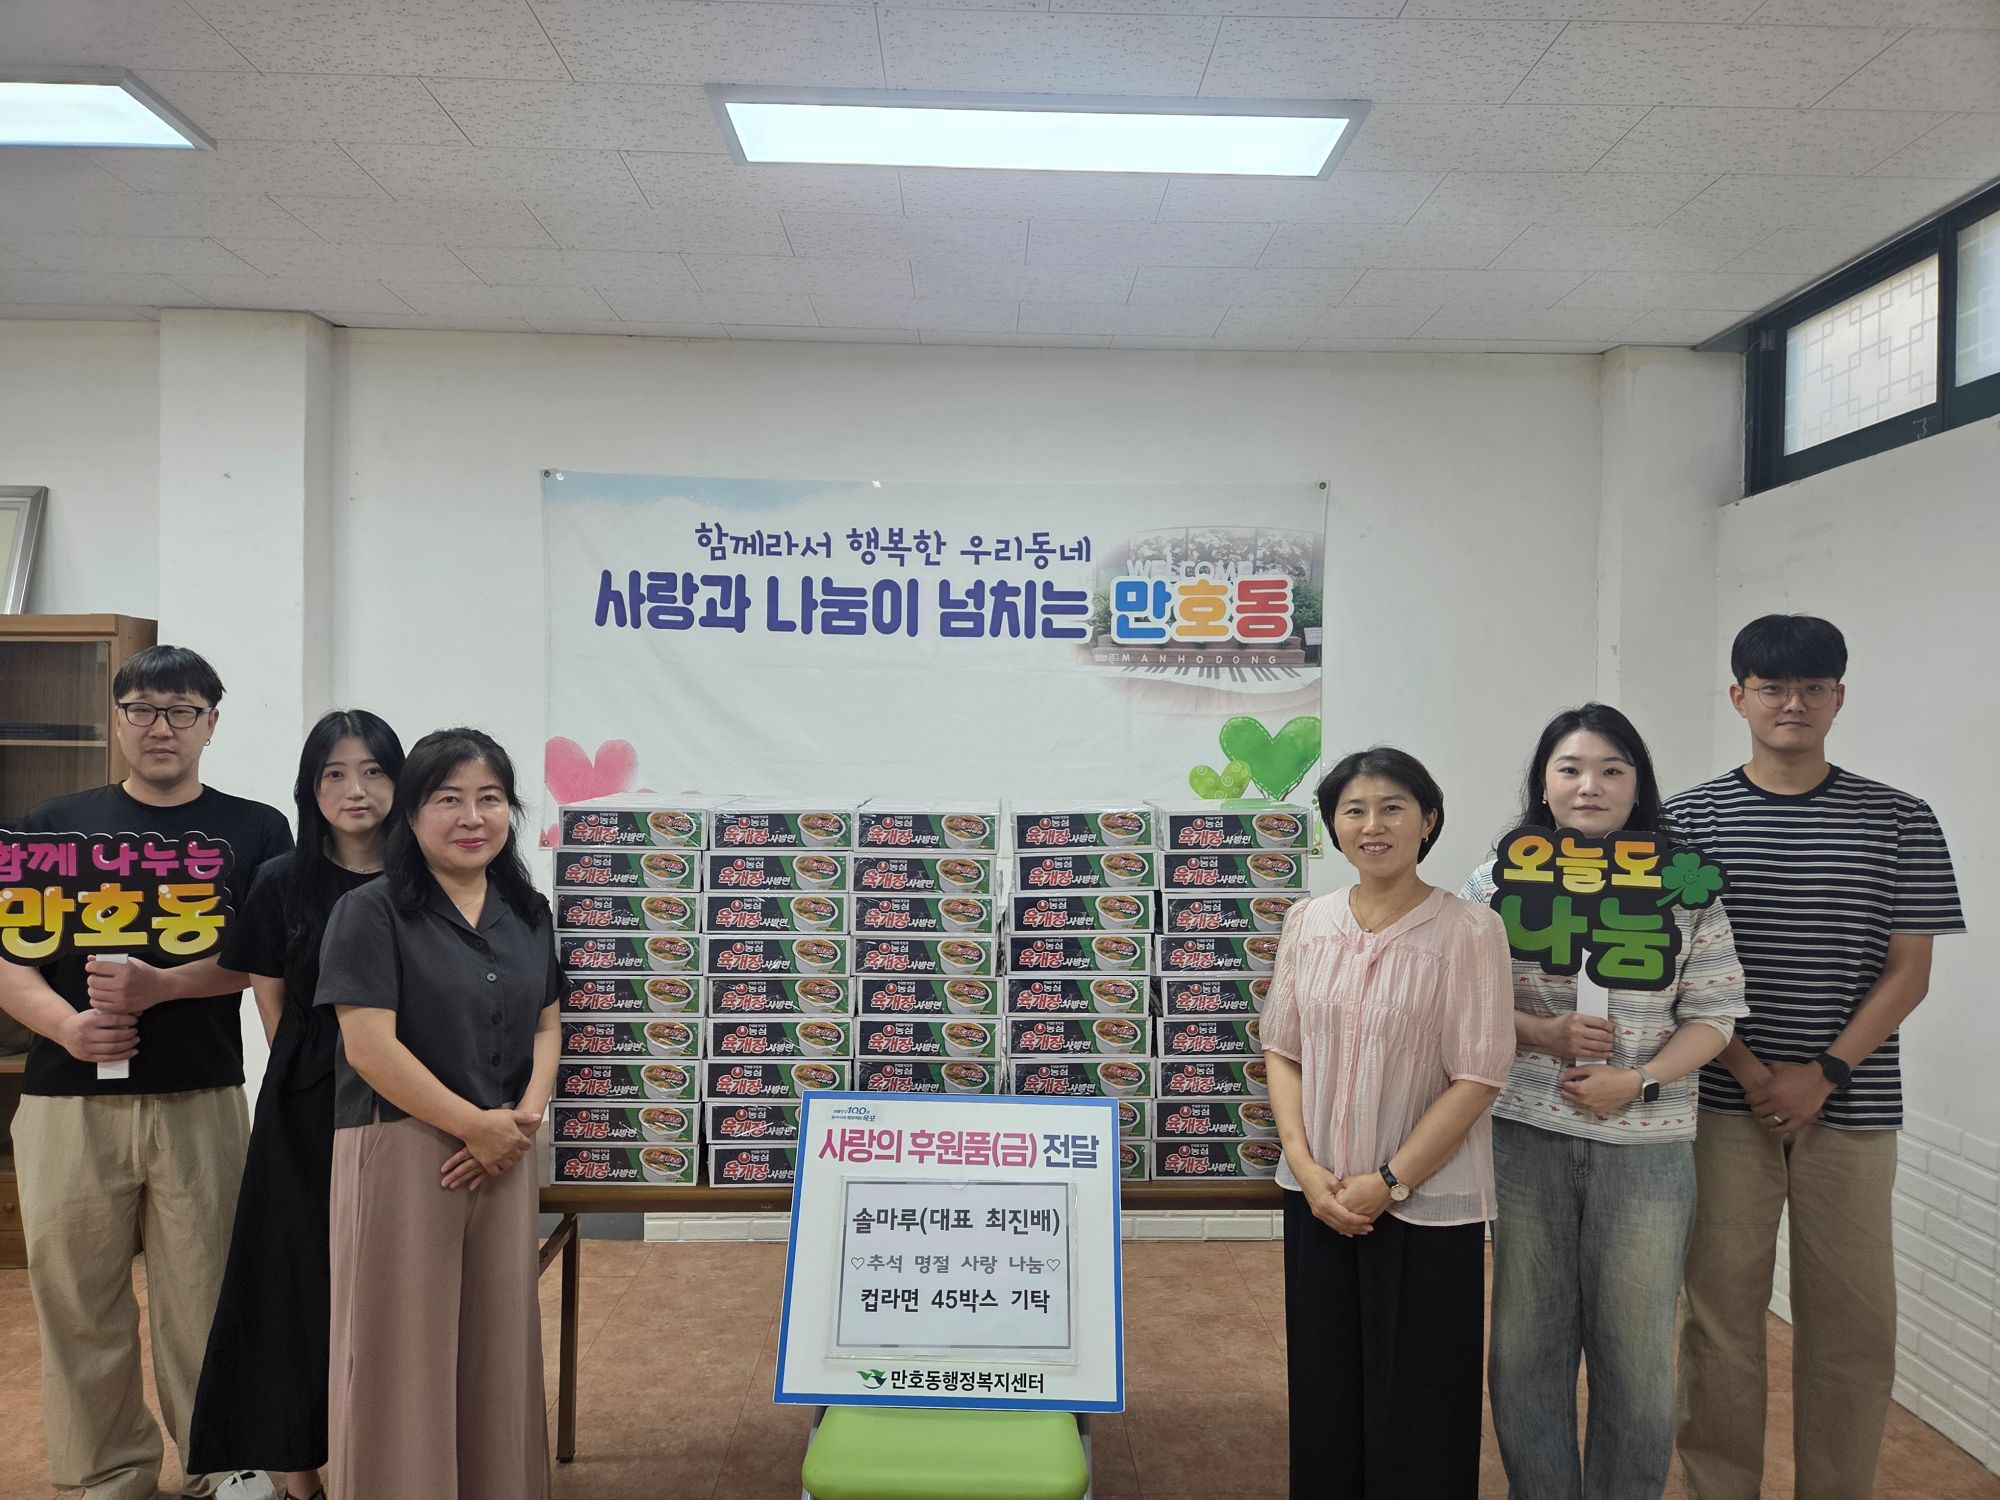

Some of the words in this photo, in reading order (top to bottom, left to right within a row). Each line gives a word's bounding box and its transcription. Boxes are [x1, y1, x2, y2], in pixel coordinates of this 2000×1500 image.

[695, 522, 832, 560] 함께라서
[847, 527, 947, 567] 행복한
[961, 533, 1091, 570] 우리동네
[594, 569, 751, 632] 사랑과
[767, 574, 918, 638] 나눔이
[938, 579, 1089, 639] 넘치는
[1114, 577, 1291, 640] 만호동
[600, 816, 618, 824] 농심
[751, 818, 769, 826] 농심
[1052, 819, 1069, 827] 농심
[572, 822, 618, 842] 육개장
[724, 825, 769, 845] 육개장
[868, 825, 912, 845] 육개장
[1026, 826, 1070, 845] 육개장
[1179, 826, 1224, 846] 육개장
[91, 840, 225, 881] 나누는
[593, 858, 612, 866] 농심
[746, 860, 764, 868] 농심
[889, 863, 907, 871] 농심
[1054, 860, 1072, 868] 농심
[1200, 859, 1218, 867] 농심
[1503, 834, 1662, 894] 오늘도
[566, 864, 611, 884] 육개장
[719, 867, 764, 887] 육개장
[862, 869, 907, 889] 육개장
[1029, 867, 1073, 886] 육개장
[1173, 866, 1218, 886] 육개장
[594, 900, 612, 908] 농심
[743, 902, 762, 910] 농심
[891, 902, 910, 910] 농심
[1049, 901, 1067, 909] 농심
[1203, 903, 1221, 911] 농심
[0, 882, 226, 959] 만호동
[567, 906, 612, 926] 육개장
[716, 908, 761, 928] 육개장
[865, 909, 909, 929] 육개장
[1023, 908, 1067, 928] 육개장
[1177, 910, 1221, 930] 육개장
[597, 942, 616, 950] 농심
[1045, 942, 1063, 950] 농심
[1196, 942, 1215, 950] 농심
[1500, 894, 1671, 980] 나눔
[570, 948, 615, 968] 육개장
[745, 944, 763, 952] 농심
[891, 944, 909, 952] 농심
[1020, 948, 1063, 968] 육개장
[1170, 948, 1215, 968] 육개장
[718, 950, 763, 970] 육개장
[864, 951, 909, 971] 육개장
[897, 984, 916, 992] 농심
[1043, 984, 1062, 992] 농심
[1202, 985, 1220, 993] 농심
[569, 990, 614, 1010] 육개장
[722, 991, 766, 1011] 육개장
[871, 991, 915, 1011] 육개장
[1017, 990, 1061, 1010] 육개장
[1177, 992, 1220, 1012] 육개장
[596, 1027, 614, 1035] 농심
[749, 1027, 767, 1035] 농심
[895, 1026, 913, 1034] 농심
[1046, 1024, 1064, 1032] 농심
[568, 1033, 614, 1053] 육개장
[722, 1034, 767, 1054] 육개장
[868, 1033, 913, 1053] 육개장
[1020, 1031, 1064, 1051] 육개장
[1173, 1032, 1217, 1052] 육개장
[593, 1069, 611, 1077] 농심
[744, 1068, 762, 1076] 농심
[895, 1067, 913, 1075] 농심
[1051, 1068, 1068, 1076] 농심
[566, 1076, 611, 1096] 육개장
[716, 1075, 762, 1095] 육개장
[1025, 1074, 1068, 1094] 육개장
[1170, 1073, 1214, 1093] 육개장
[591, 1112, 609, 1120] 농심
[748, 1110, 766, 1118] 농심
[1192, 1108, 1210, 1116] 농심
[564, 1119, 609, 1139] 육개장
[721, 1117, 766, 1137] 육개장
[1165, 1114, 1210, 1134] 육개장
[591, 1152, 610, 1160] 농심
[751, 1153, 769, 1161] 농심
[818, 1128, 902, 1164] 사랑의
[907, 1130, 1038, 1169] 후원품(금)
[1043, 1134, 1100, 1169] 전달
[1191, 1147, 1209, 1155] 농심
[564, 1159, 610, 1179] 육개장
[724, 1160, 769, 1181] 육개장
[1165, 1154, 1209, 1174] 육개장
[852, 1208, 974, 1235] 솔마루(대표
[985, 1208, 1060, 1236] 최진배)
[866, 1255, 903, 1274] 추석
[914, 1255, 950, 1274] 명절
[961, 1256, 998, 1275] 사랑
[1008, 1256, 1045, 1275] 나눔
[860, 1288, 920, 1313] 컵라면
[931, 1288, 999, 1313] 45박스
[1010, 1289, 1050, 1314] 기탁
[890, 1369, 1045, 1394] 만호동행정복지센터
